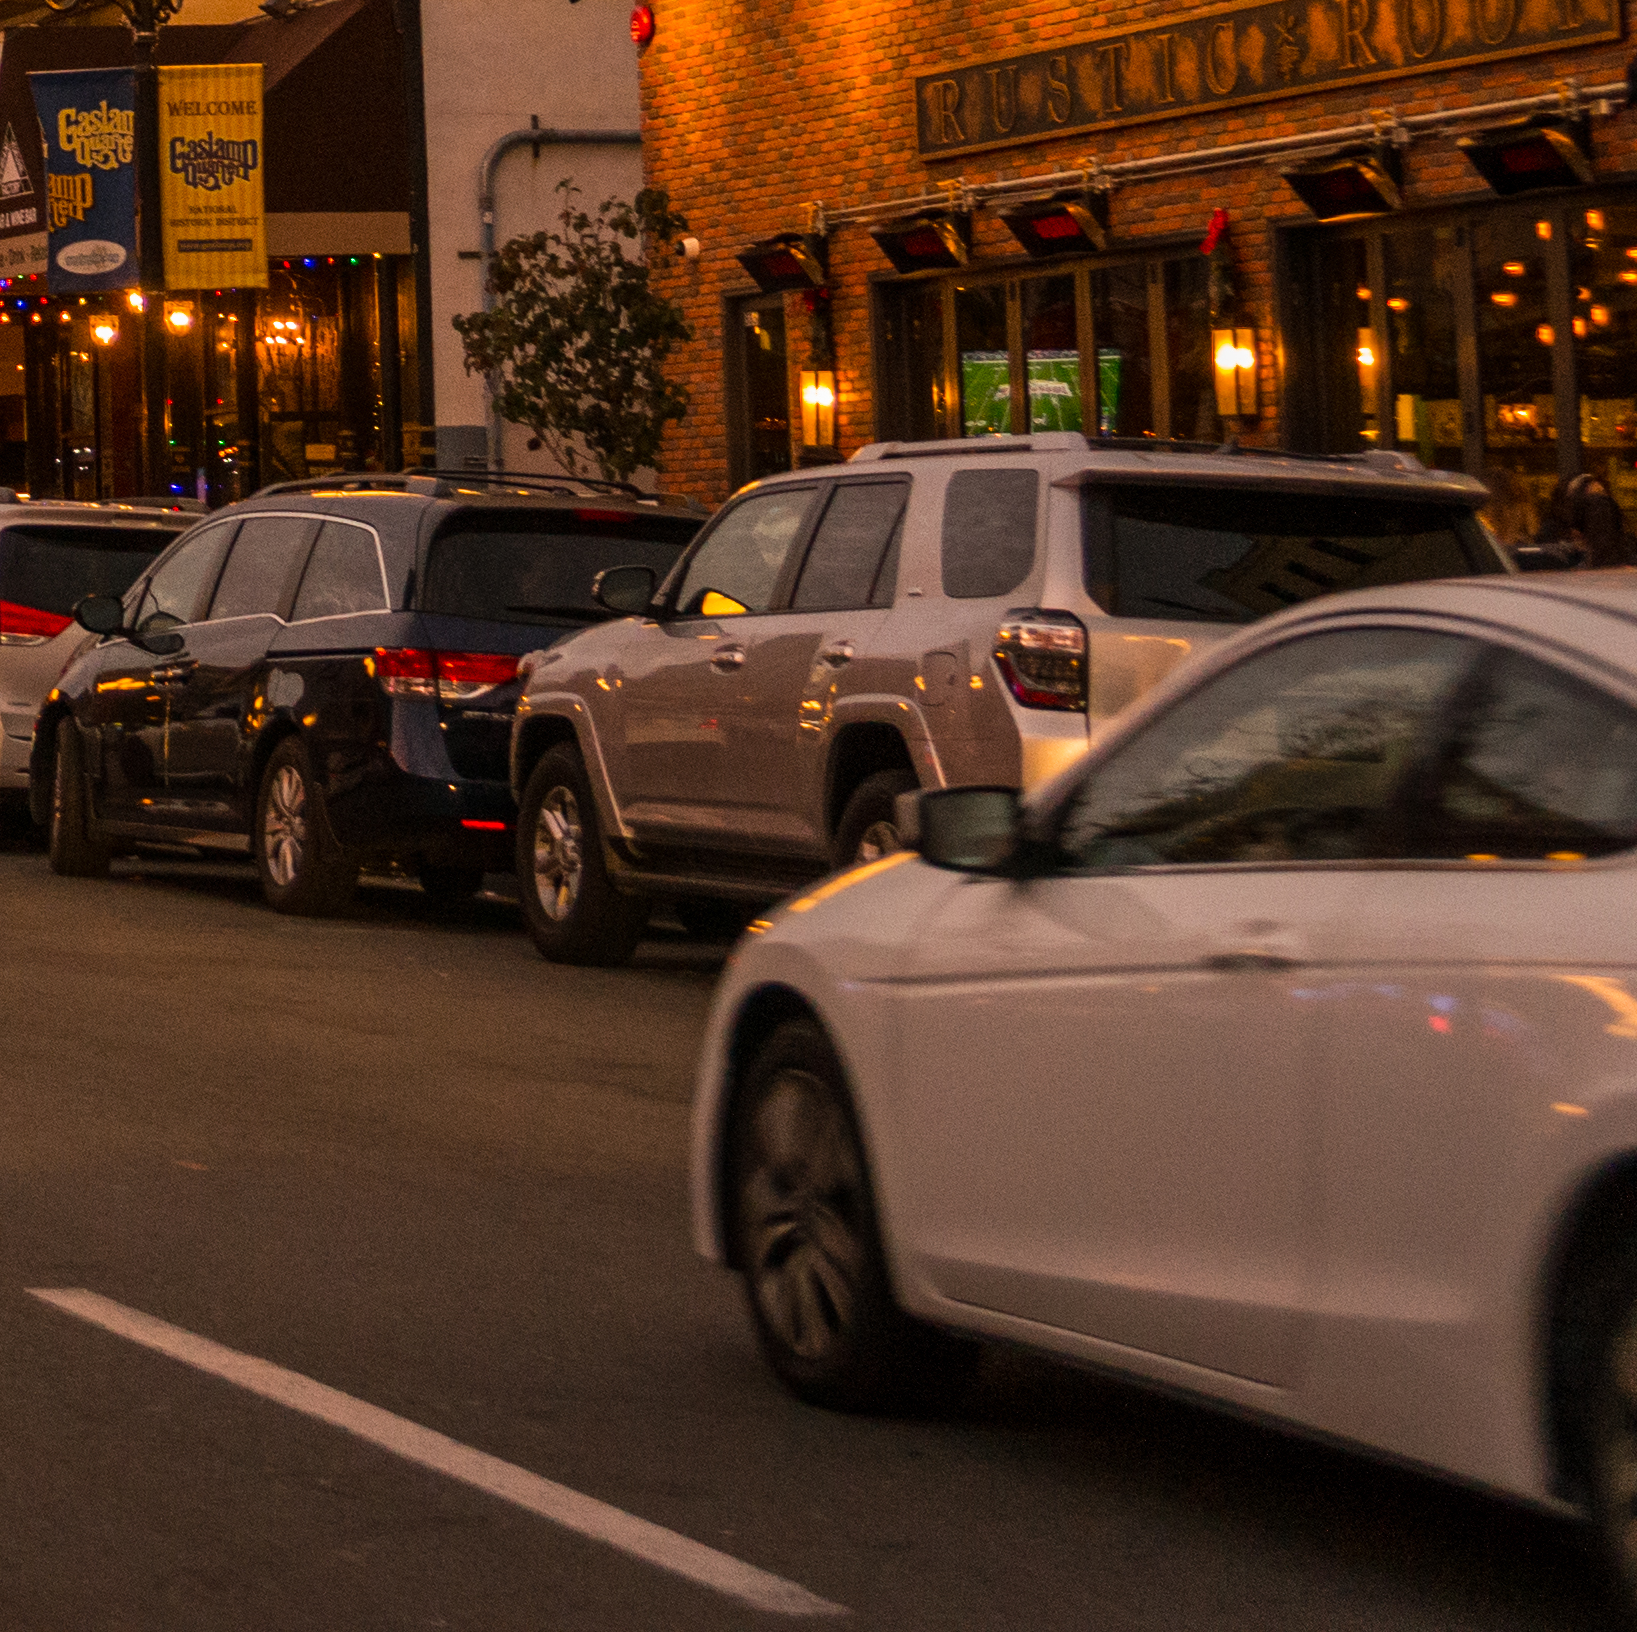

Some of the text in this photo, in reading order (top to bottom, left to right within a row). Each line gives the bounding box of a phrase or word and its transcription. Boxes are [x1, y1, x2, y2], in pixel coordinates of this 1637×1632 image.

[926, 22, 1233, 146] RUSTIC
[167, 100, 257, 116] WELCOME
[169, 131, 258, 174] Gaslamp
